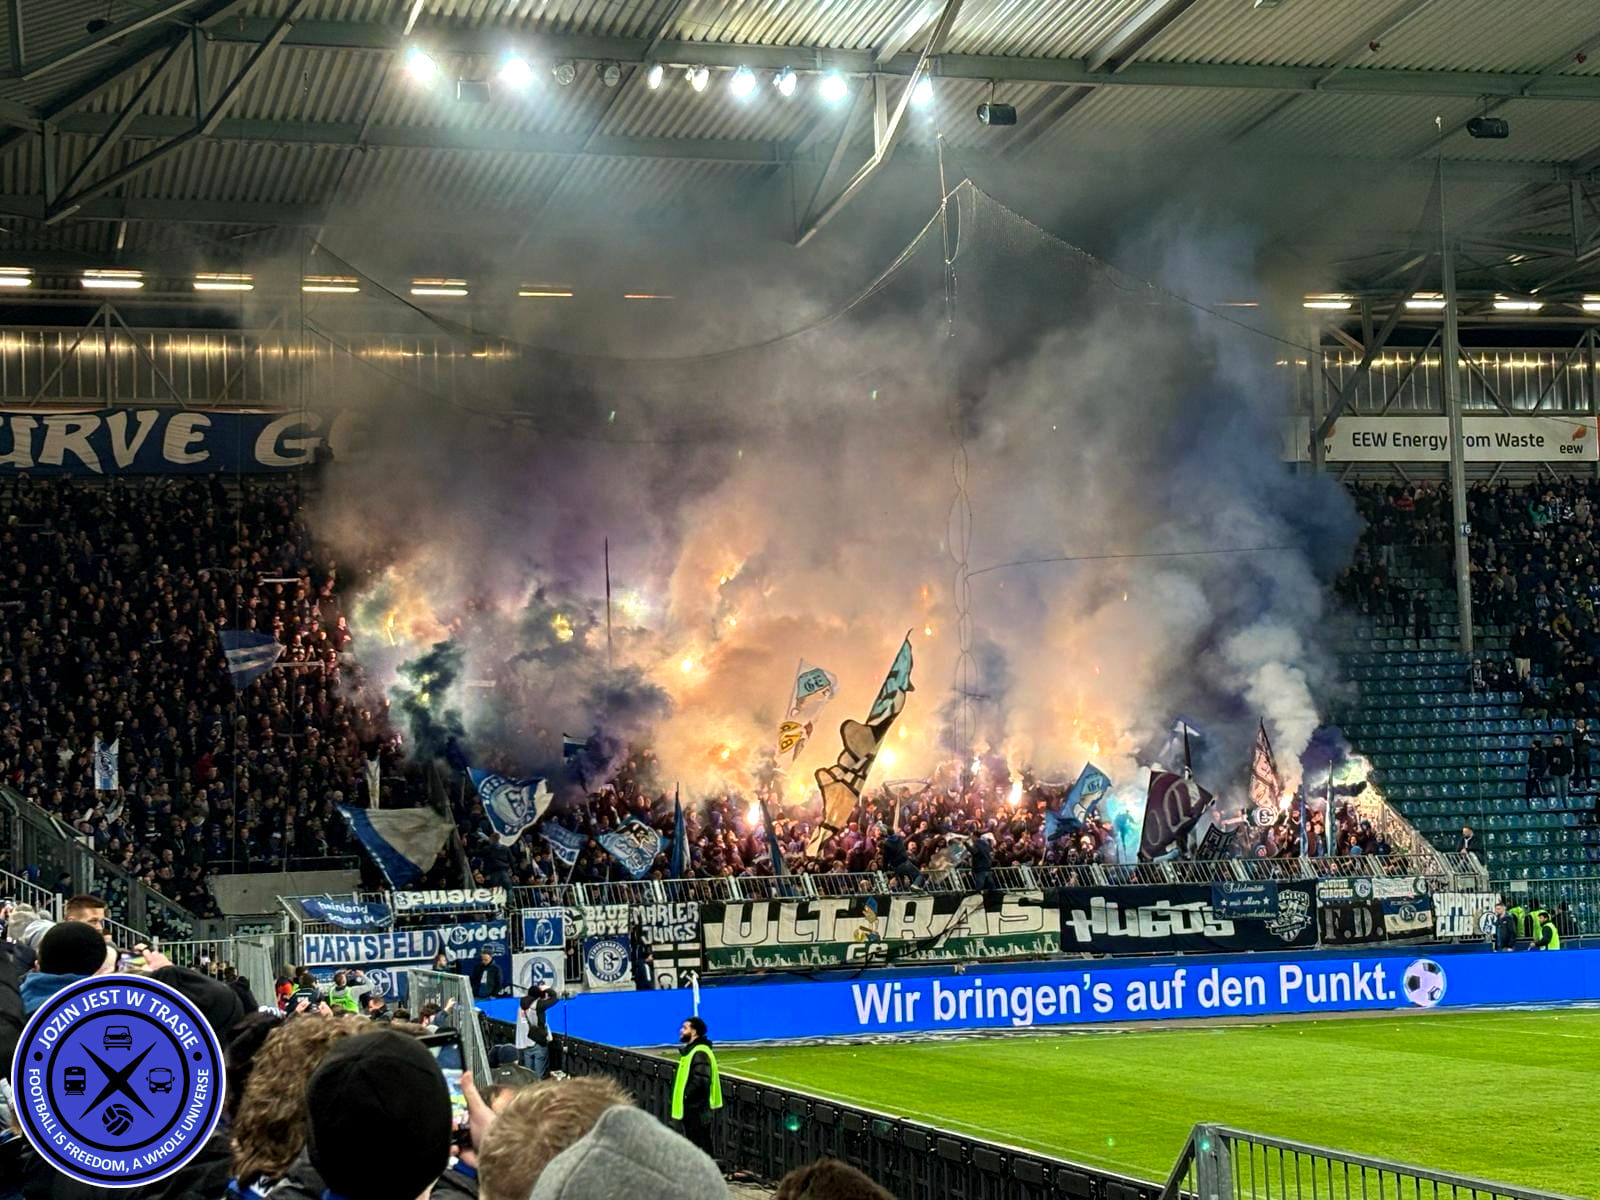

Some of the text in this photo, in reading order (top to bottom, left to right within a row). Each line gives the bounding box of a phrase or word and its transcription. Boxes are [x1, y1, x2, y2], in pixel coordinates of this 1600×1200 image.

[1352, 432, 1545, 451] EEW Energy rom Waste
[1559, 444, 1584, 454] eew
[583, 904, 629, 921] BLUE
[630, 901, 699, 926] MARLER
[721, 891, 1045, 948] ULTRAS
[586, 920, 629, 937] BOYZ
[641, 922, 697, 945] JUNGS
[1436, 915, 1474, 938] CLUB
[852, 962, 1396, 1027] Wir bringen's auf den Punkt.
